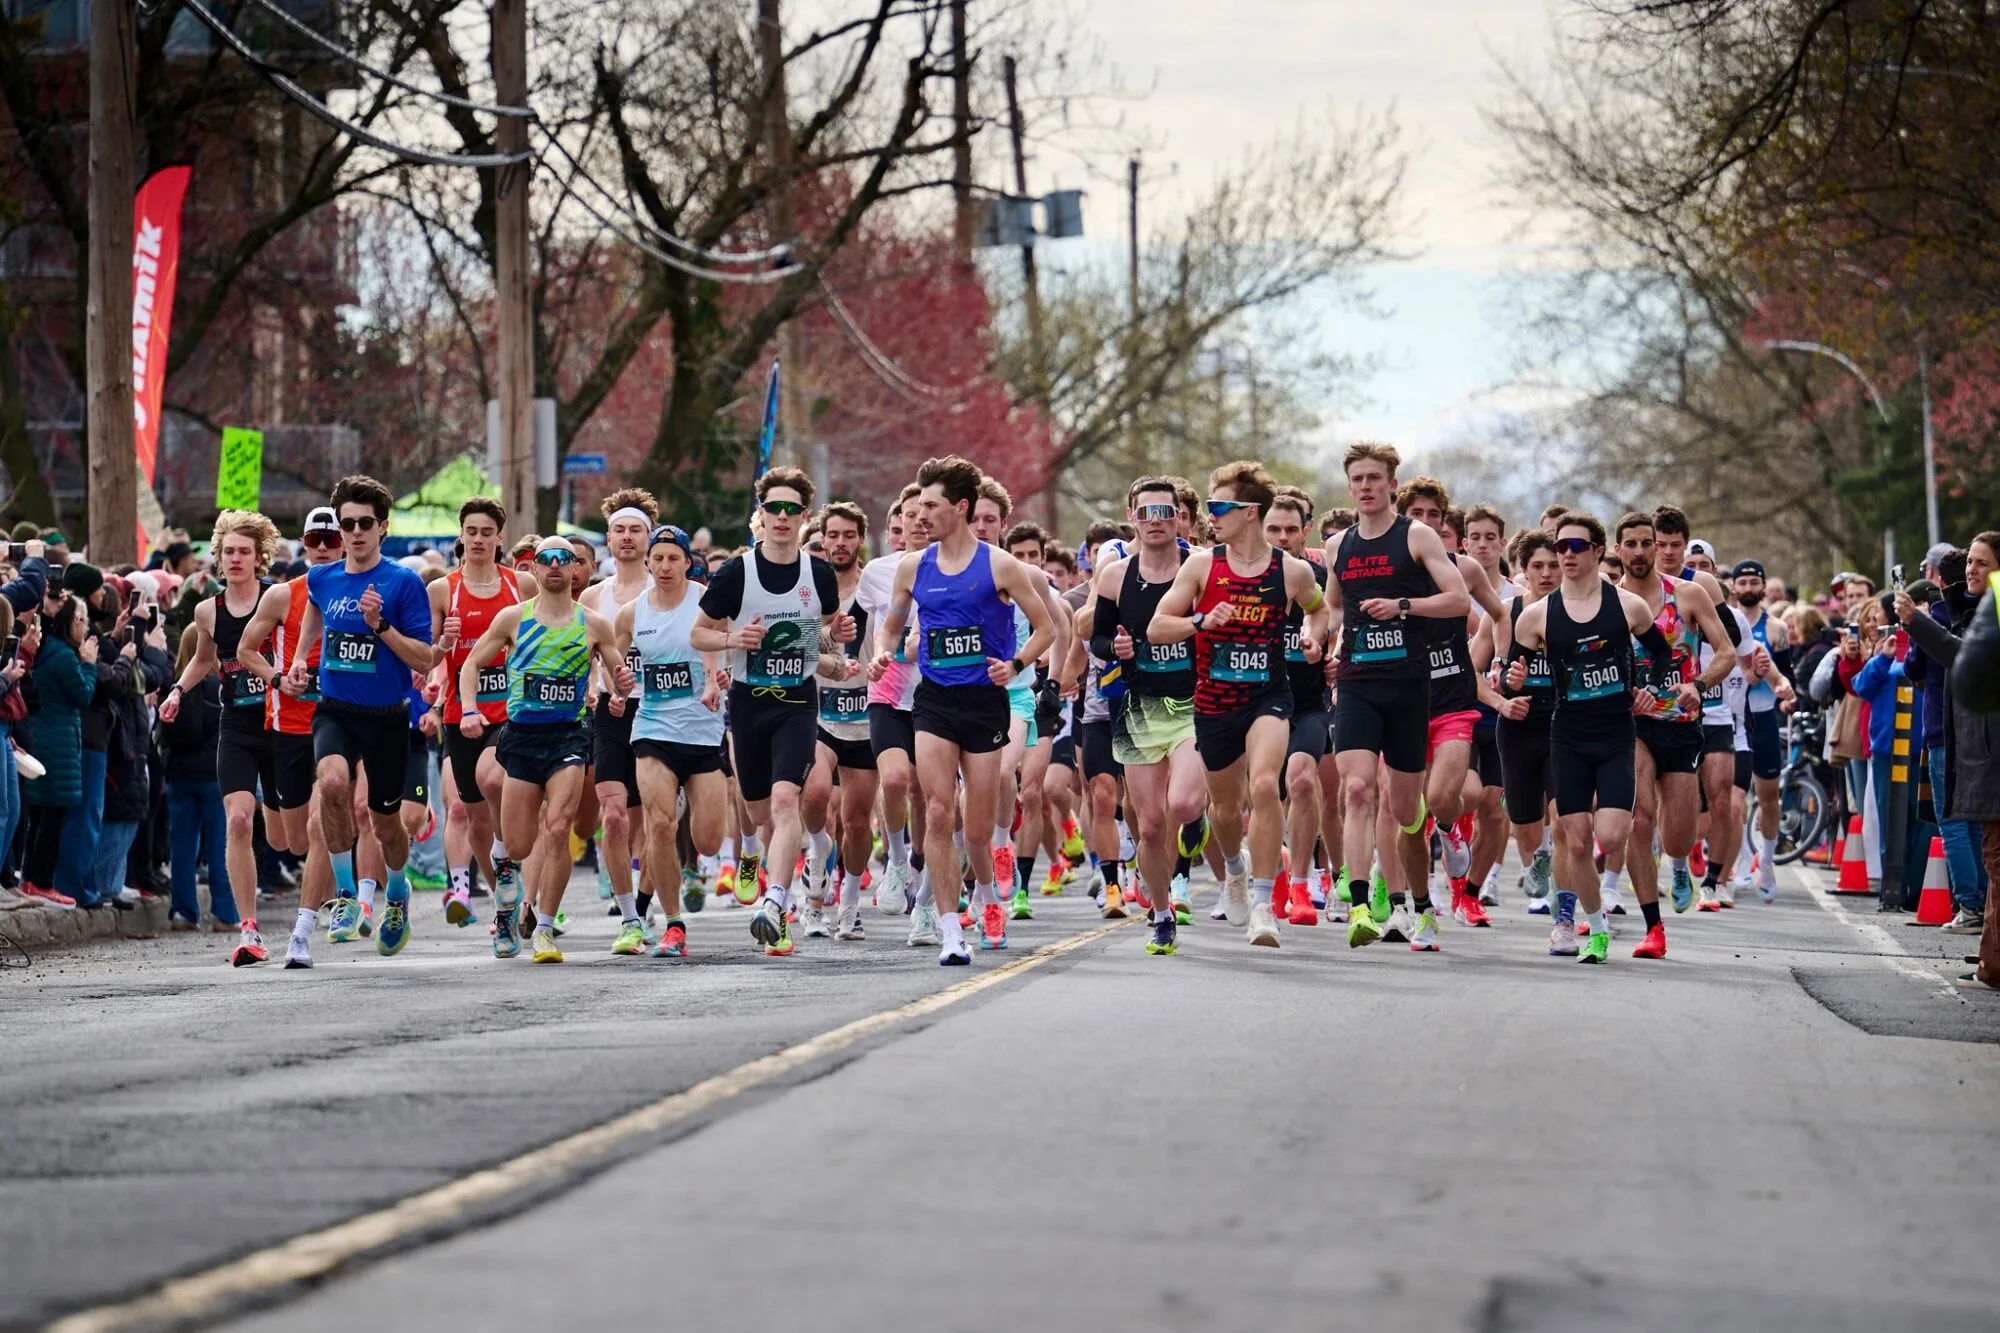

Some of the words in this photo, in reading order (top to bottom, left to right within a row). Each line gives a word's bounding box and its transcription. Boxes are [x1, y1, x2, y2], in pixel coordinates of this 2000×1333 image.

[1347, 555, 1390, 569] ÉLITE
[1341, 566, 1395, 581] DISTANCE
[764, 610, 801, 620] montreal
[1231, 606, 1269, 623] LECT
[945, 634, 981, 655] 5675
[1366, 629, 1404, 650] 5668
[339, 641, 374, 661] 5047
[1151, 641, 1188, 662] 5045
[1230, 651, 1268, 670] 5043
[1429, 649, 1454, 668] 013
[766, 658, 802, 675] 5048
[247, 677, 269, 693] 53
[656, 671, 690, 690] 5042
[1583, 665, 1620, 689] 5040
[540, 684, 575, 701] 5055
